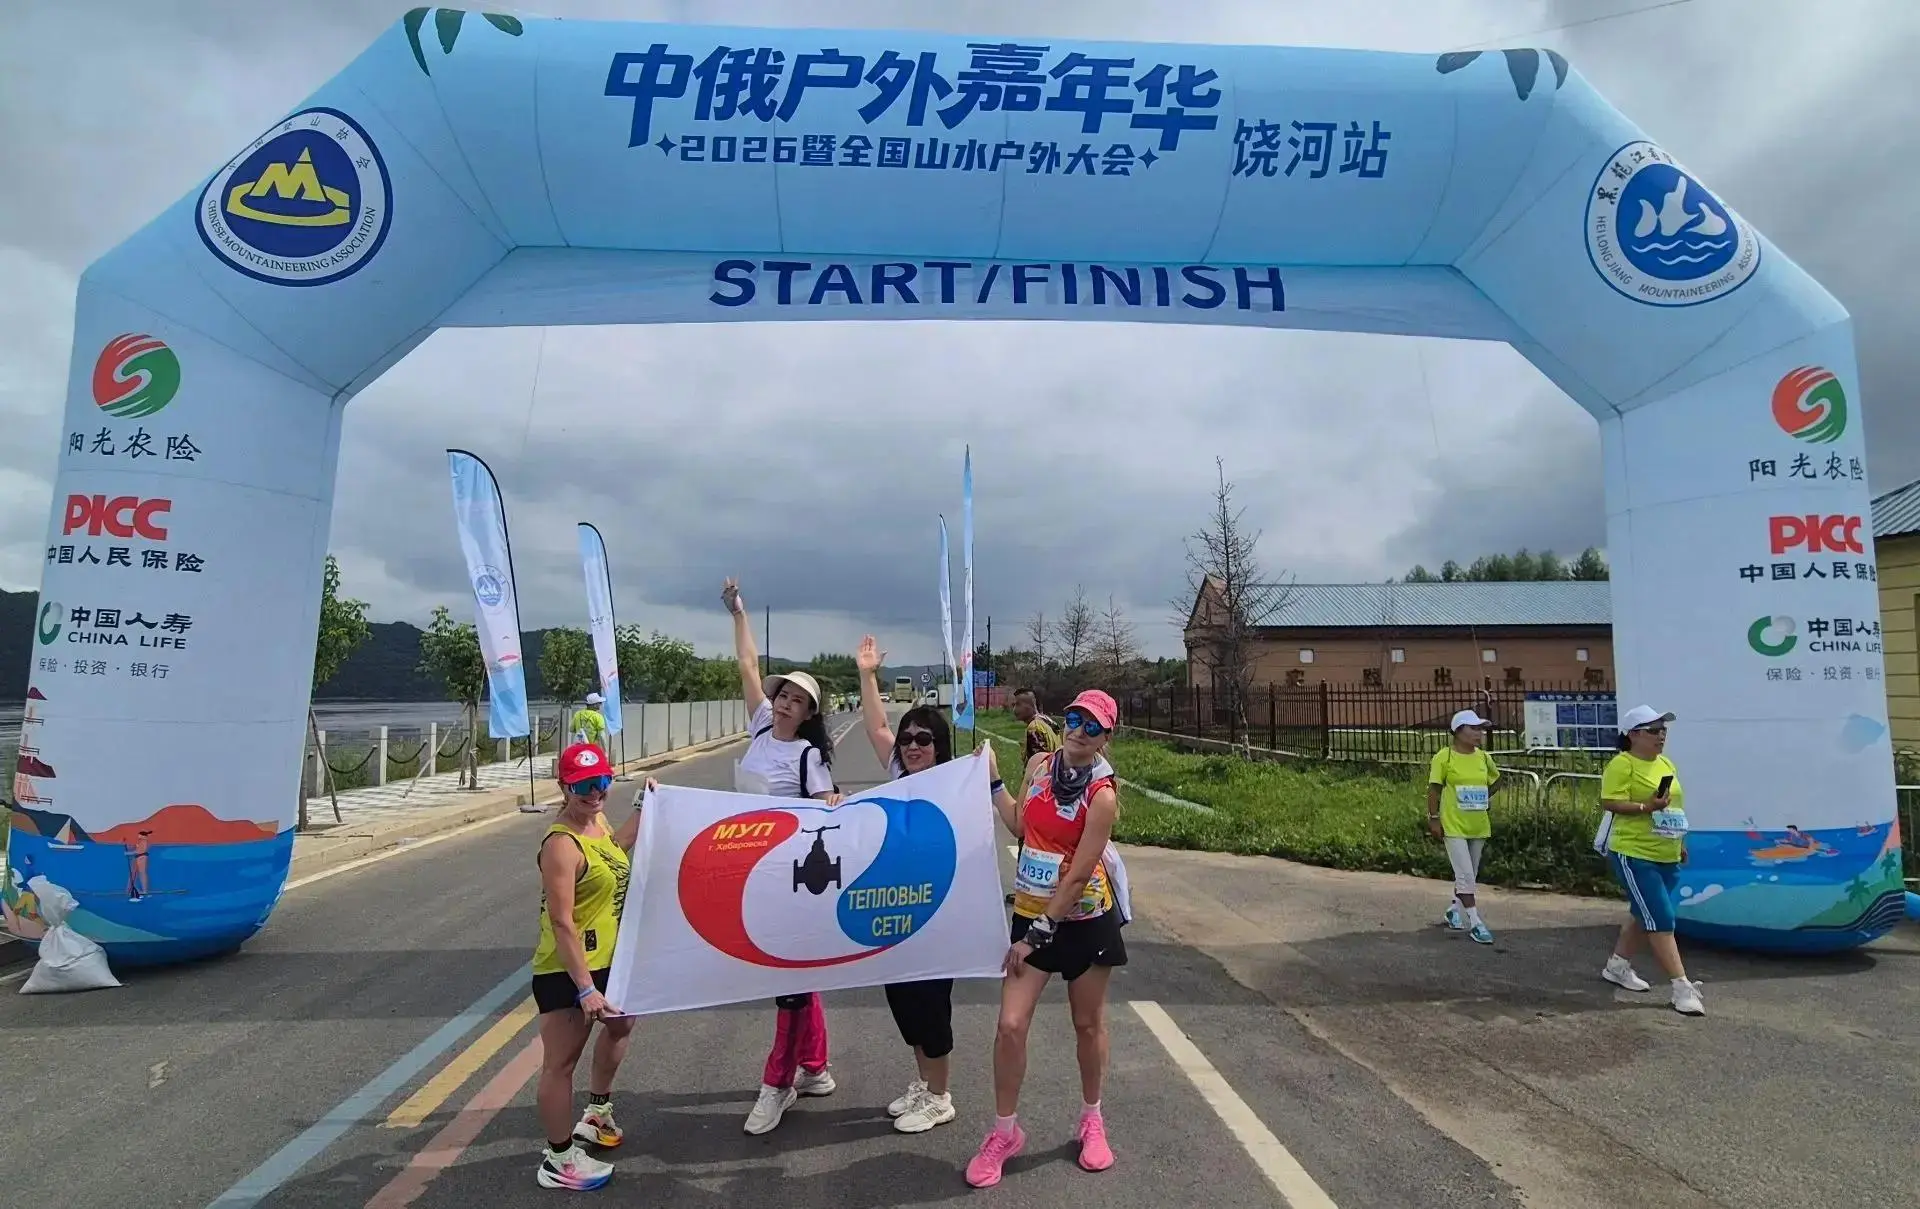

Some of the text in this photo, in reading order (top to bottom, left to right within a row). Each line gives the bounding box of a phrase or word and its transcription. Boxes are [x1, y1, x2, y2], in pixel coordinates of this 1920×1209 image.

[604, 43, 1222, 151] 中俄户外嘉年华
[679, 134, 1137, 176] 2026暨全国山水户外大会
[1232, 118, 1391, 178] 饶河站
[208, 200, 377, 272] CHINESE MOUNTAINEERING ASSOCIATION
[709, 258, 1285, 311] START/FINISH
[1638, 272, 1735, 299] MOUNTAINEERING
[68, 426, 201, 461] 阳光农险
[1748, 451, 1863, 481] 阳光农险
[63, 494, 172, 541] PICC
[1769, 514, 1864, 554] PICC
[47, 545, 205, 573] 中国人民保险
[70, 606, 193, 634] 中国人寿
[68, 631, 187, 650] CHINA LIFE
[1809, 641, 1861, 652] CHINA
[712, 822, 776, 840] МУП
[717, 840, 768, 851] Хабаровска
[1022, 863, 1053, 882] A1330
[848, 882, 933, 910] ТЕПЛОВЫЕ
[872, 914, 912, 936] СЕТИ
